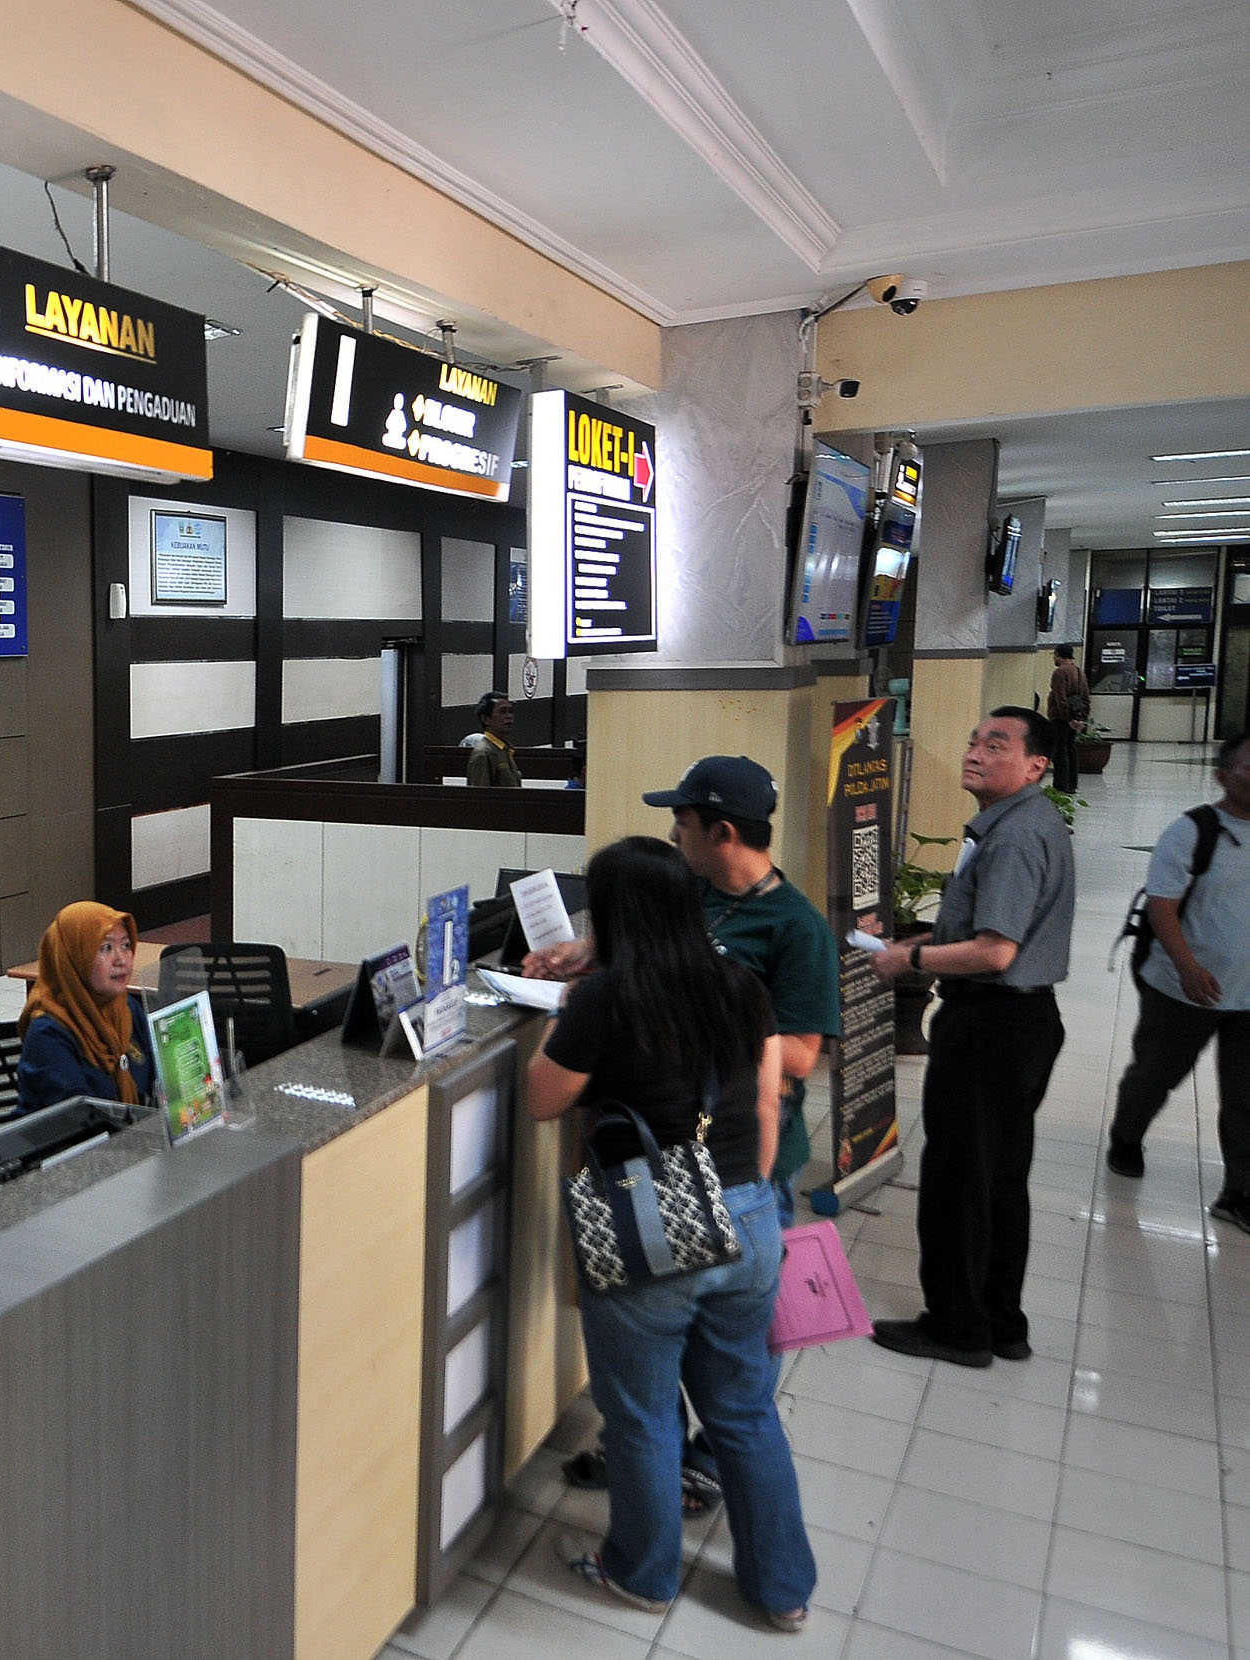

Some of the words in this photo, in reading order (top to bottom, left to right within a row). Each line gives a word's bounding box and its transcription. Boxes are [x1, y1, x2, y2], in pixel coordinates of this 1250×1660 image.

[25, 283, 156, 358] LAYANAN
[82, 375, 116, 410] DAN
[117, 385, 197, 427] PENGADUAN
[330, 334, 357, 427] I
[439, 363, 498, 407] LAYANAN
[568, 409, 635, 477] LOKET-I
